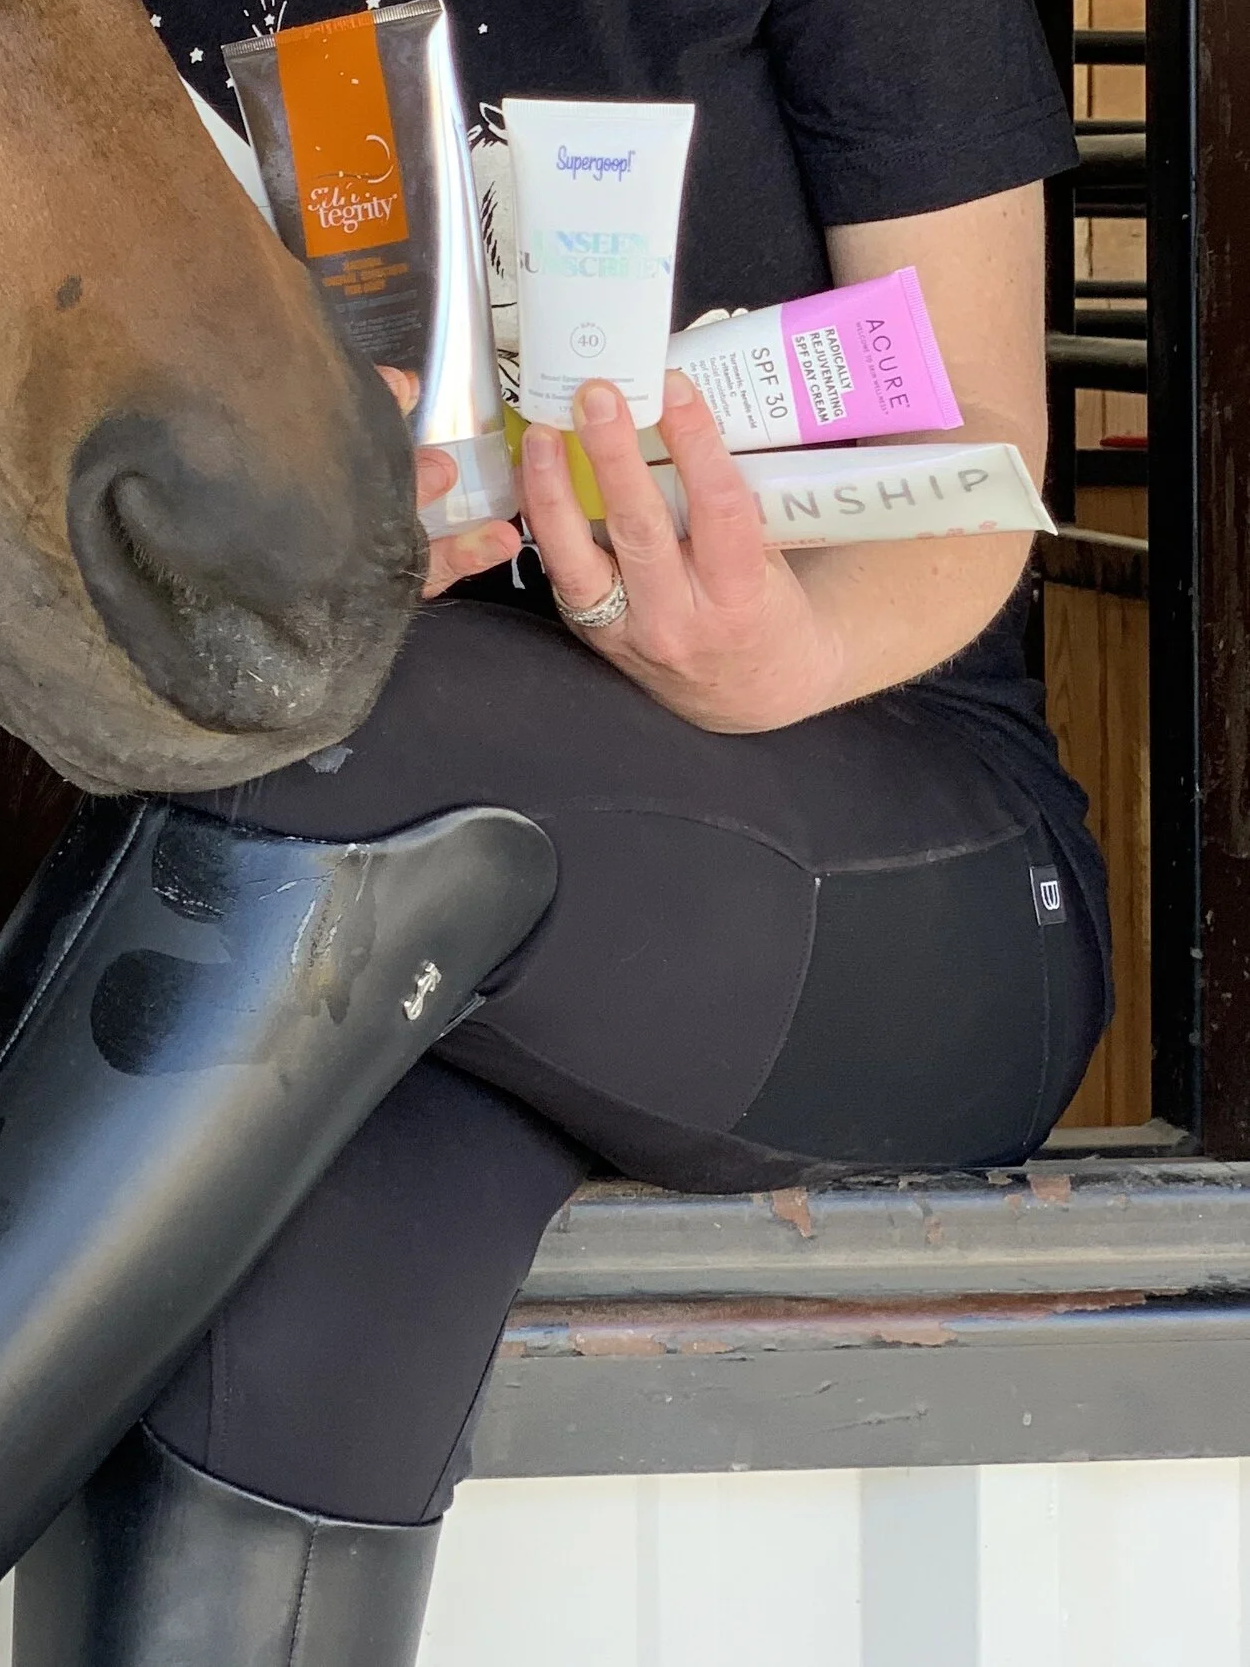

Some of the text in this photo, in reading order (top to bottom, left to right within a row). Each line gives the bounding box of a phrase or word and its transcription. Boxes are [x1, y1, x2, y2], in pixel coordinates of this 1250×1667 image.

[556, 145, 634, 182] Supergoop!
[318, 194, 394, 234] tegrity
[578, 334, 600, 348] 40
[825, 328, 852, 390] RADICALLY
[865, 318, 910, 410] ACURE
[751, 347, 788, 419] SPF 30
[795, 336, 830, 423] SPF DAY CREAM
[810, 332, 845, 418] REJUVENATING
[752, 468, 989, 524] INSHIP
